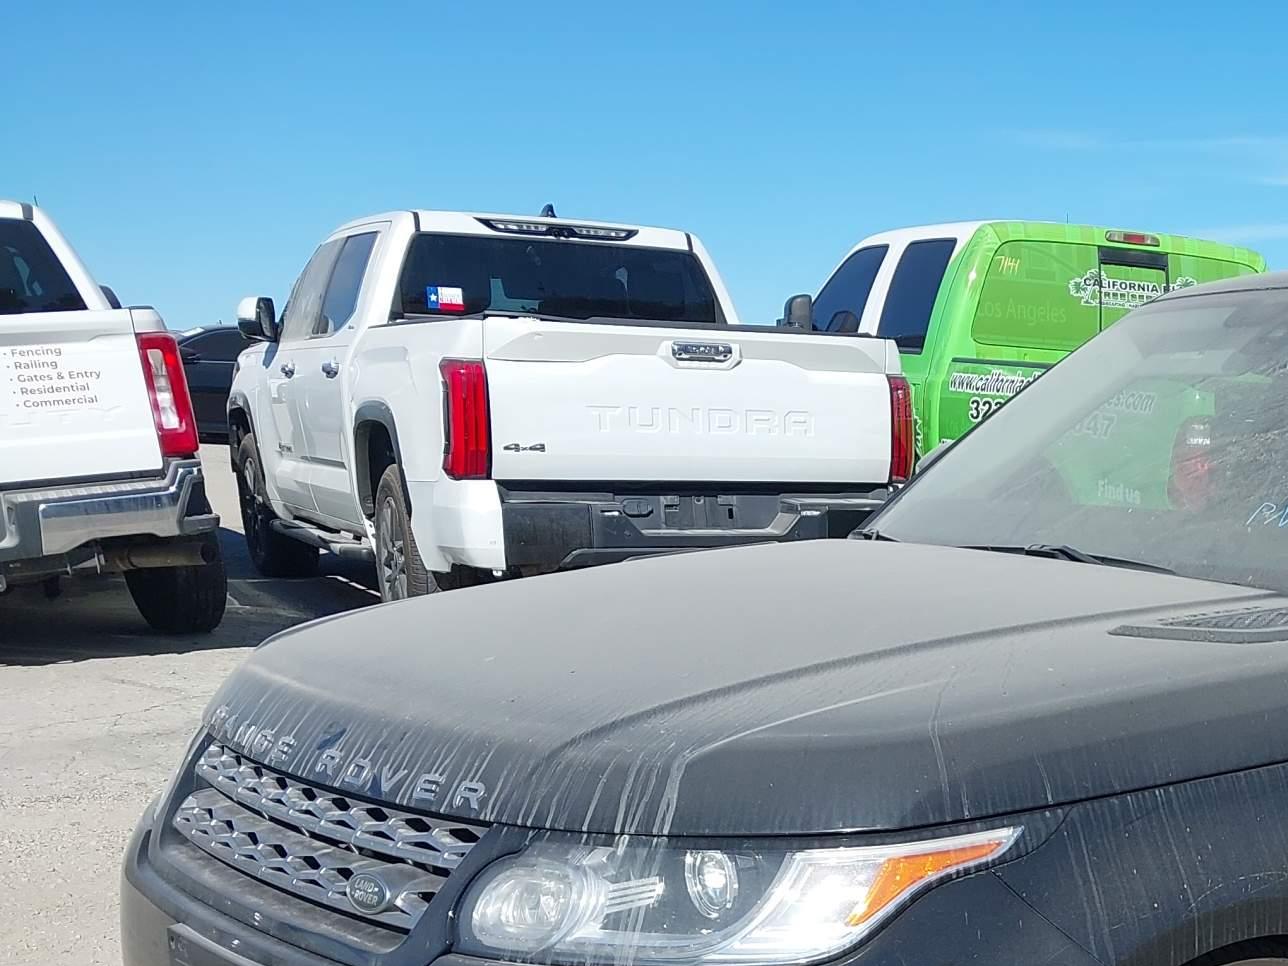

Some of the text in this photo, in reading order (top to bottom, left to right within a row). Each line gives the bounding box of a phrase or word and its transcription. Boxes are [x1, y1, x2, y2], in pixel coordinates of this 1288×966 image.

[1084, 278, 1159, 293] CALIFORNIA
[1006, 299, 1067, 326] Angeles
[11, 347, 62, 357] Fencing
[14, 360, 58, 370] Railing
[17, 370, 101, 383] Gates & Entry
[20, 382, 90, 396] Residential
[23, 395, 98, 408] Commercial
[585, 406, 815, 437] TUNDRA
[503, 443, 546, 453] 4x4
[211, 705, 487, 811] RANGE ROVER
